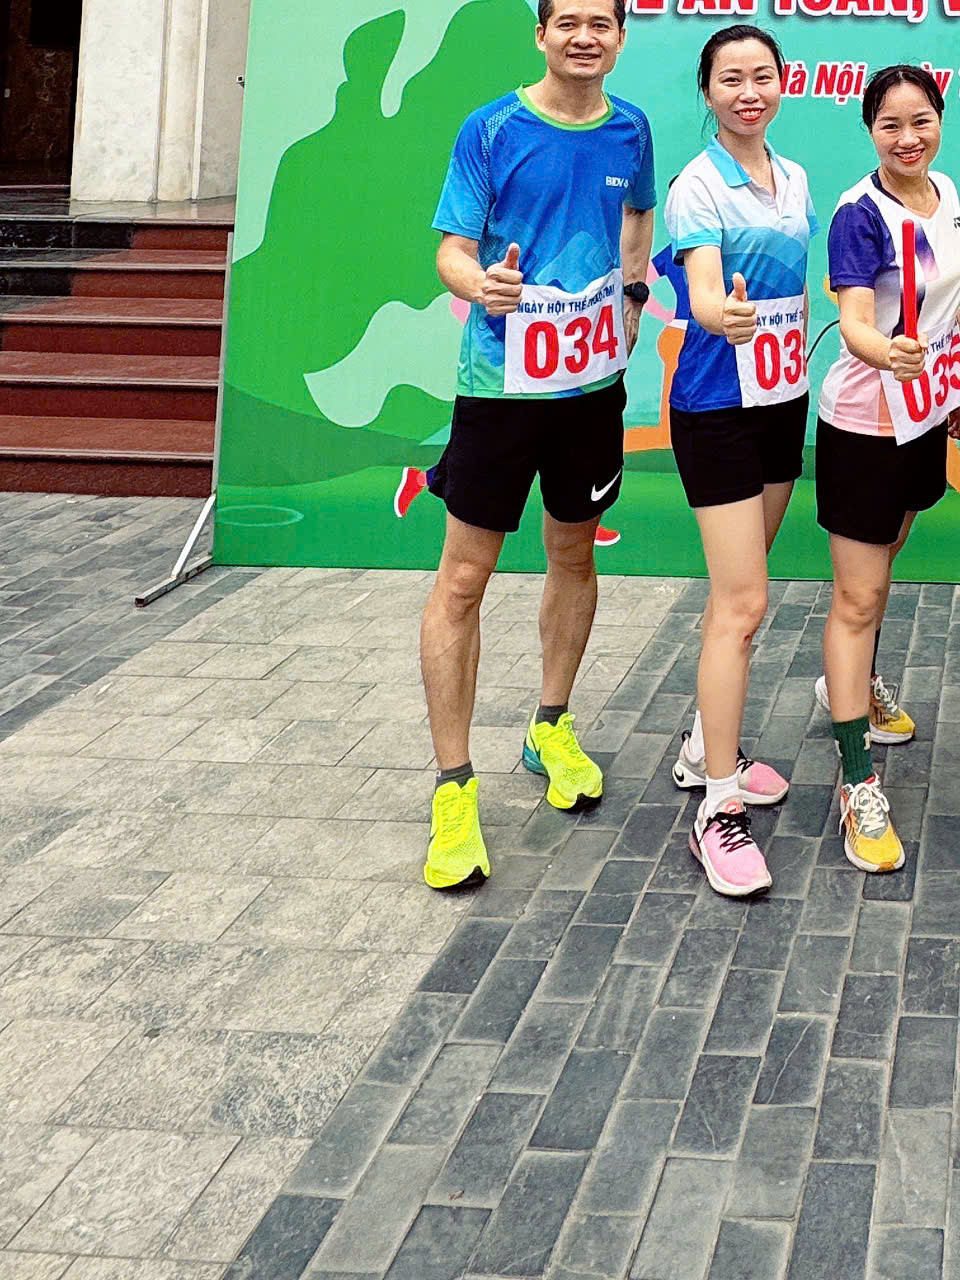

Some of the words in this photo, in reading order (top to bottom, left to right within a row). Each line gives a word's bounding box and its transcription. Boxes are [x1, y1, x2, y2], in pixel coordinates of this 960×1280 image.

[517, 300, 544, 314] NGÀY
[547, 300, 566, 316] HỘI
[568, 295, 588, 313] THỂ
[756, 313, 767, 327] ÀY
[769, 312, 783, 328] HỘI
[524, 304, 619, 380] 034
[753, 329, 807, 391] 03
